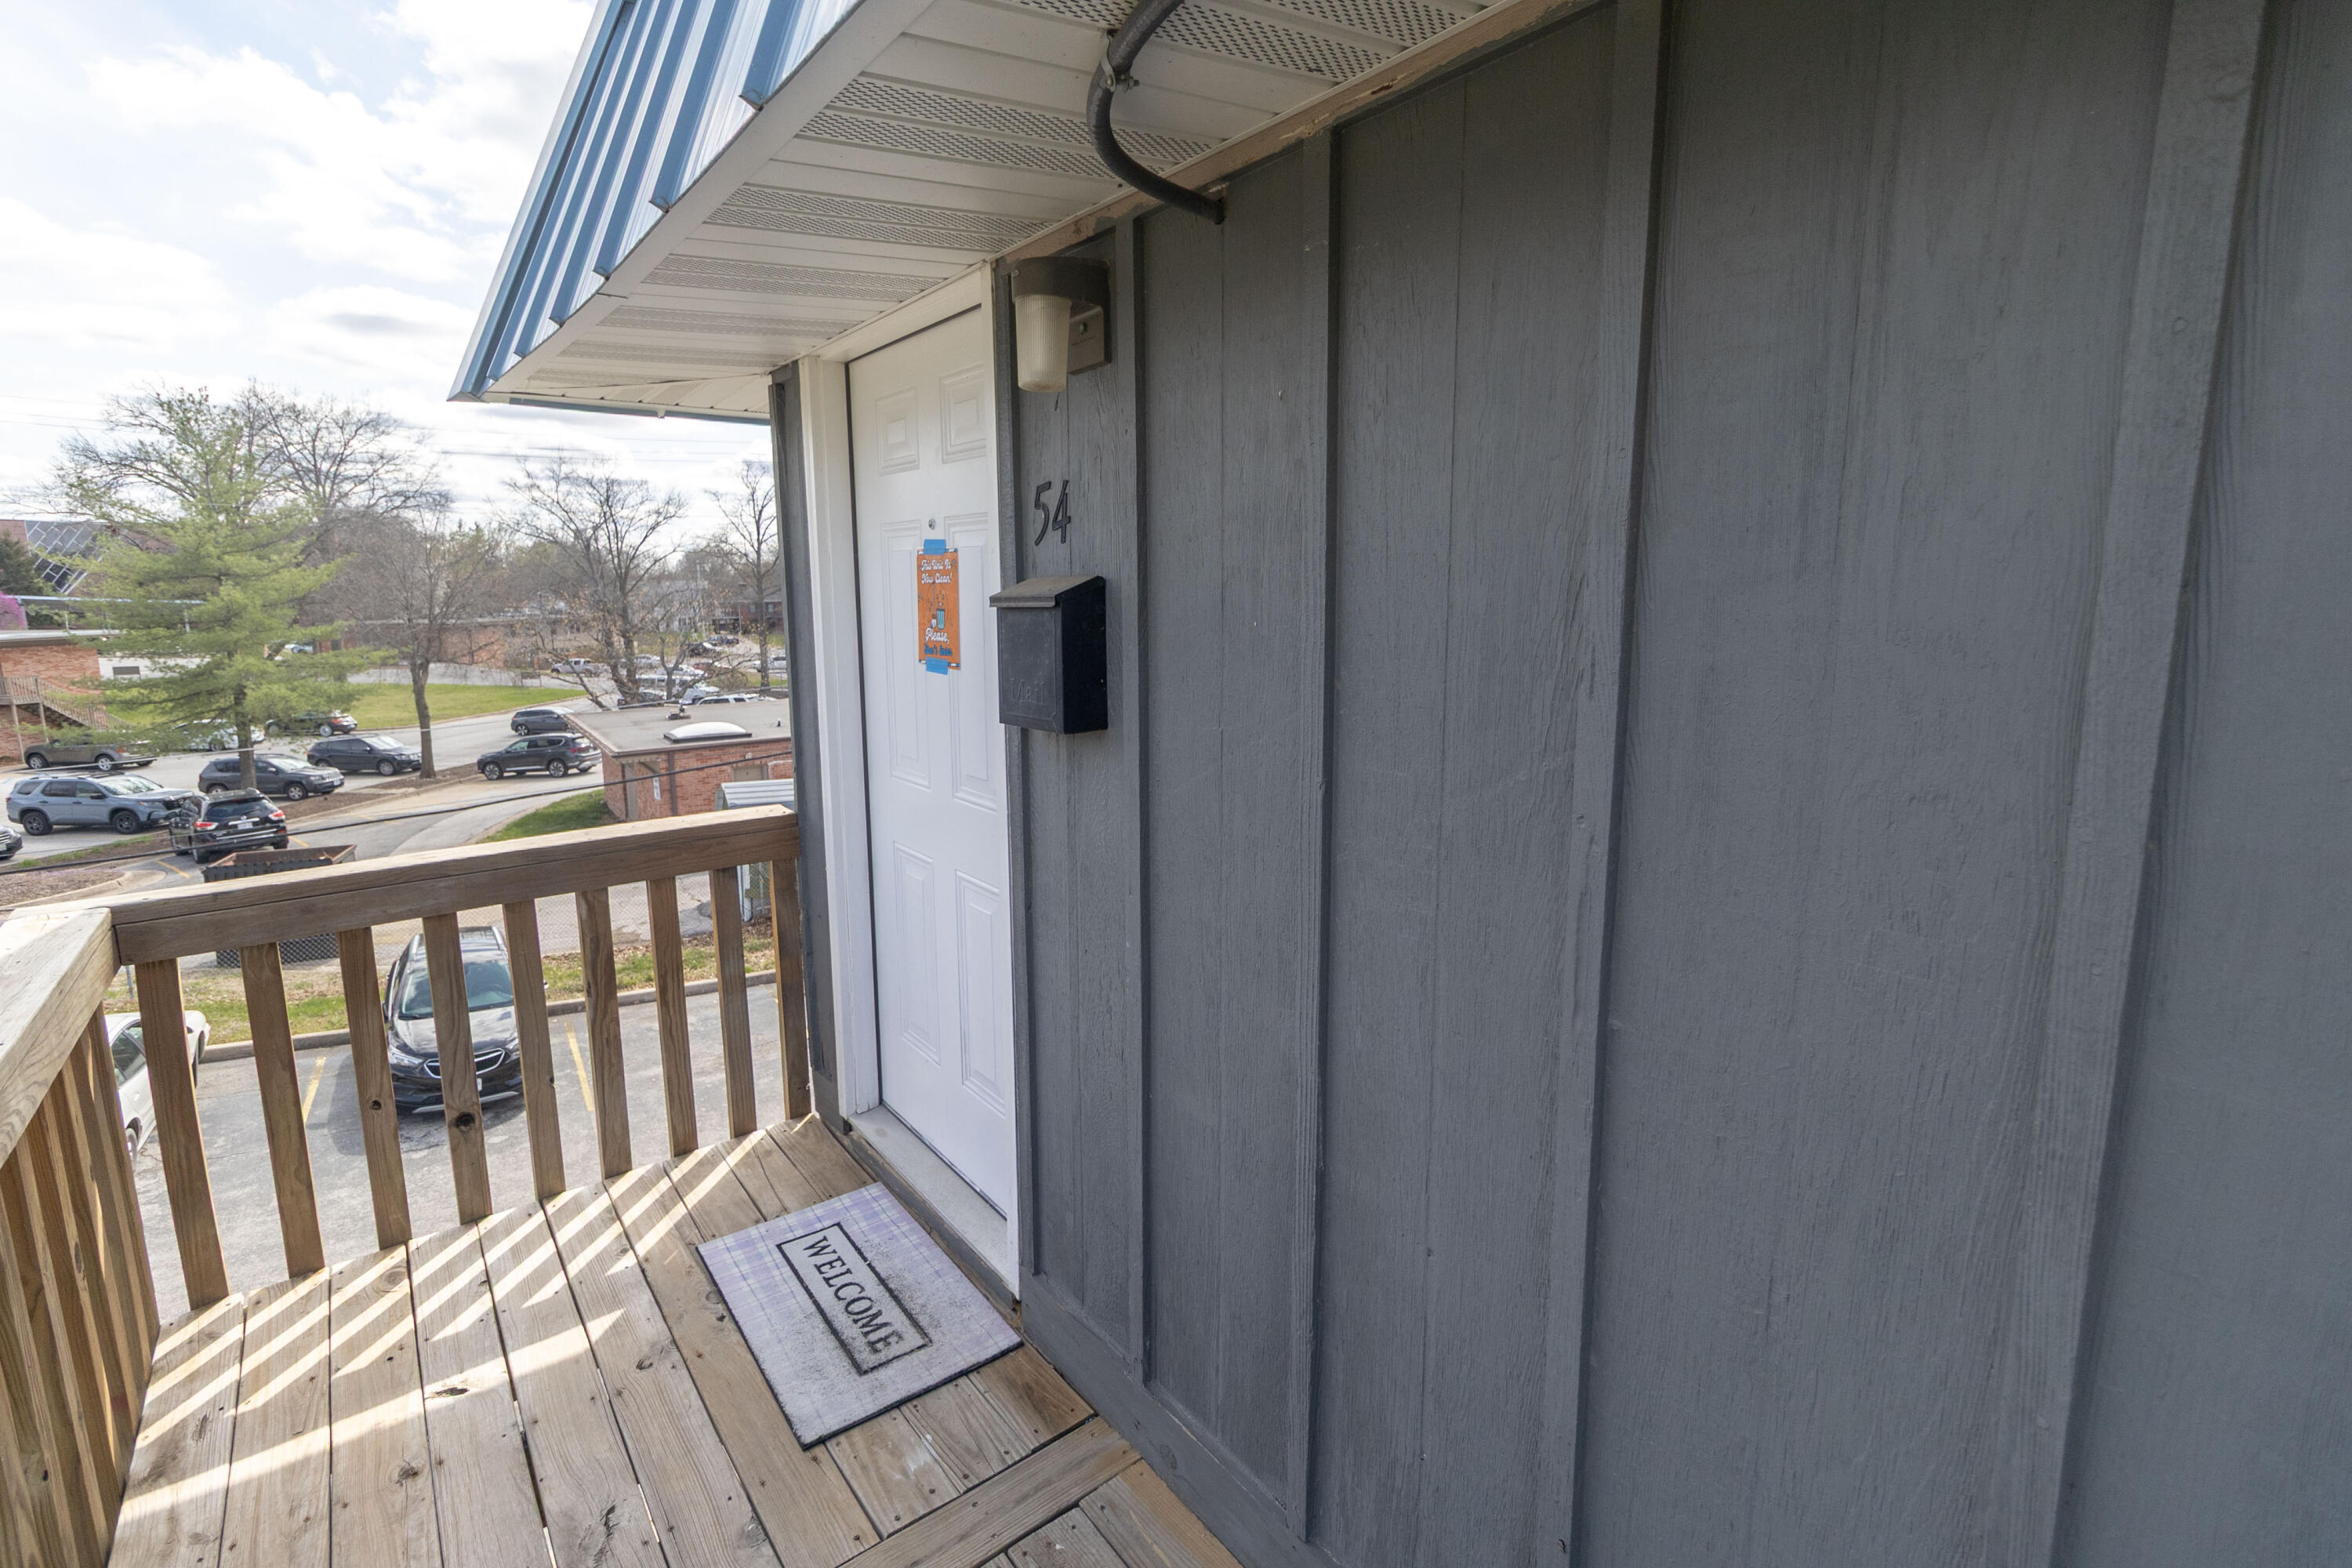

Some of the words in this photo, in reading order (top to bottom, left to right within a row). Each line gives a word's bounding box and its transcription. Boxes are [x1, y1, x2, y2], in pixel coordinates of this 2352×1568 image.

[1034, 479, 1071, 546] 54
[920, 559, 931, 571] This
[931, 559, 943, 570] Unit
[921, 572, 934, 584] Now
[935, 572, 953, 583] Clean!
[924, 627, 949, 644] Please,
[1009, 677, 1047, 705] Mail
[803, 1236, 902, 1355] WELCOME
